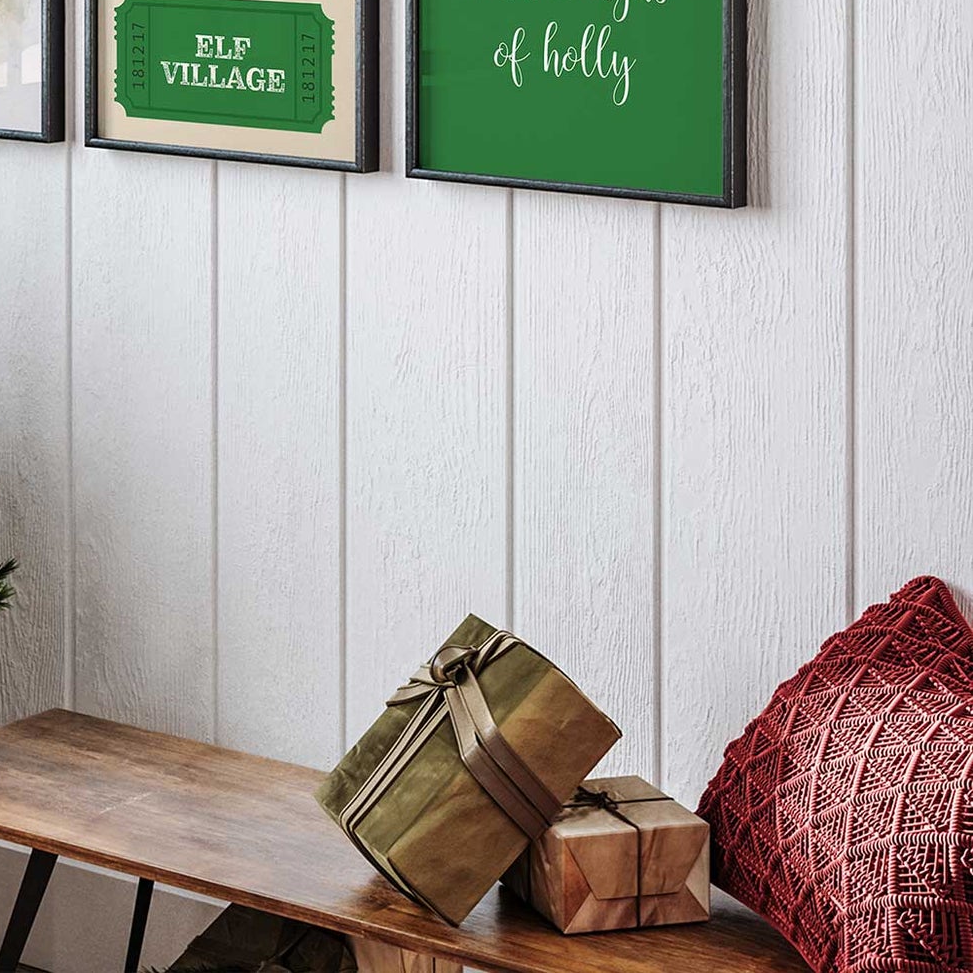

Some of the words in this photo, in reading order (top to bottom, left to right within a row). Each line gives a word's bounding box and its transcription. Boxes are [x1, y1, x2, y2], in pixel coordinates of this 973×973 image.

[132, 23, 145, 90] 181217
[161, 61, 285, 93] VILLAGE
[195, 34, 251, 60] ELF
[302, 34, 316, 104] 181217
[493, 27, 530, 88] of
[544, 21, 637, 106] holly
